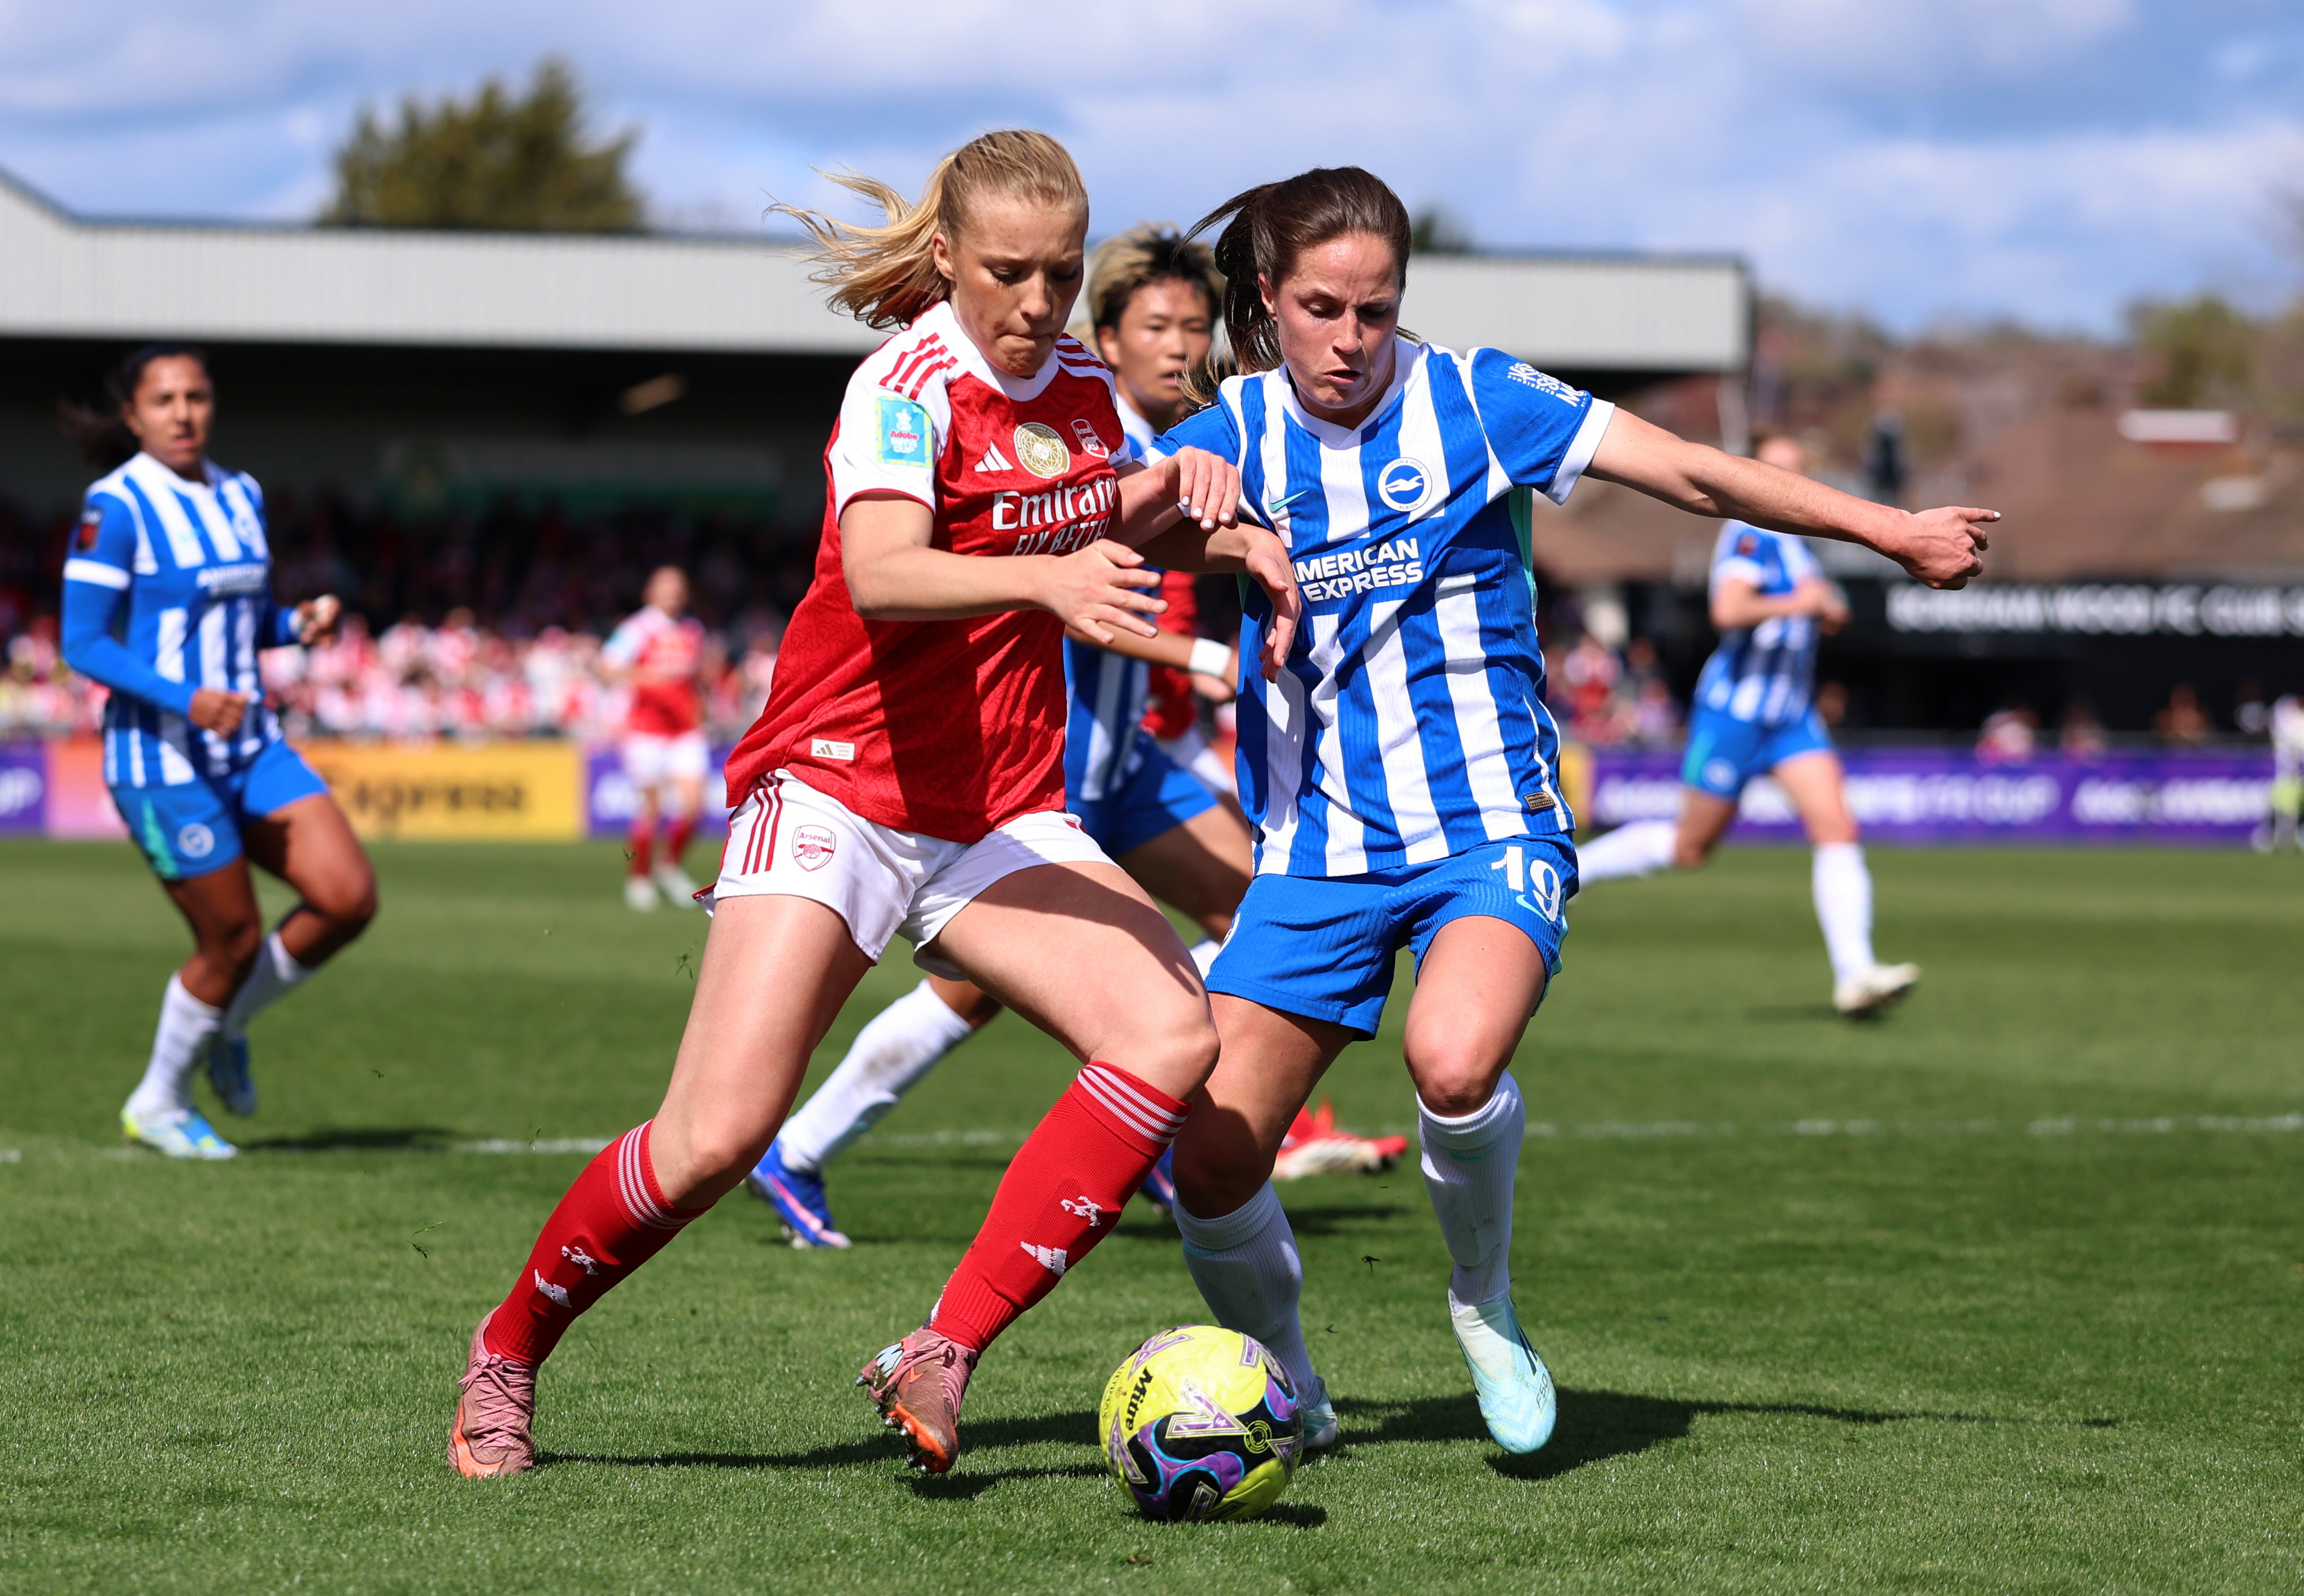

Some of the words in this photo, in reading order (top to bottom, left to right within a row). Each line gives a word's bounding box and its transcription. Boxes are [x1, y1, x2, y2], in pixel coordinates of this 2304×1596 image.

[890, 430, 918, 440] Adobe
[893, 445, 915, 454] CUP
[1382, 460, 1404, 477] BRIGHTON
[1410, 461, 1423, 470] HOVE
[992, 474, 1117, 530] Emirate
[1048, 517, 1110, 554] BETTE
[1303, 561, 1423, 602] EXPRESS
[799, 832, 830, 843] Arsenal
[1491, 846, 1561, 922] 19
[1126, 1366, 1153, 1431] Mitre
[1536, 1373, 1548, 1409] F50
